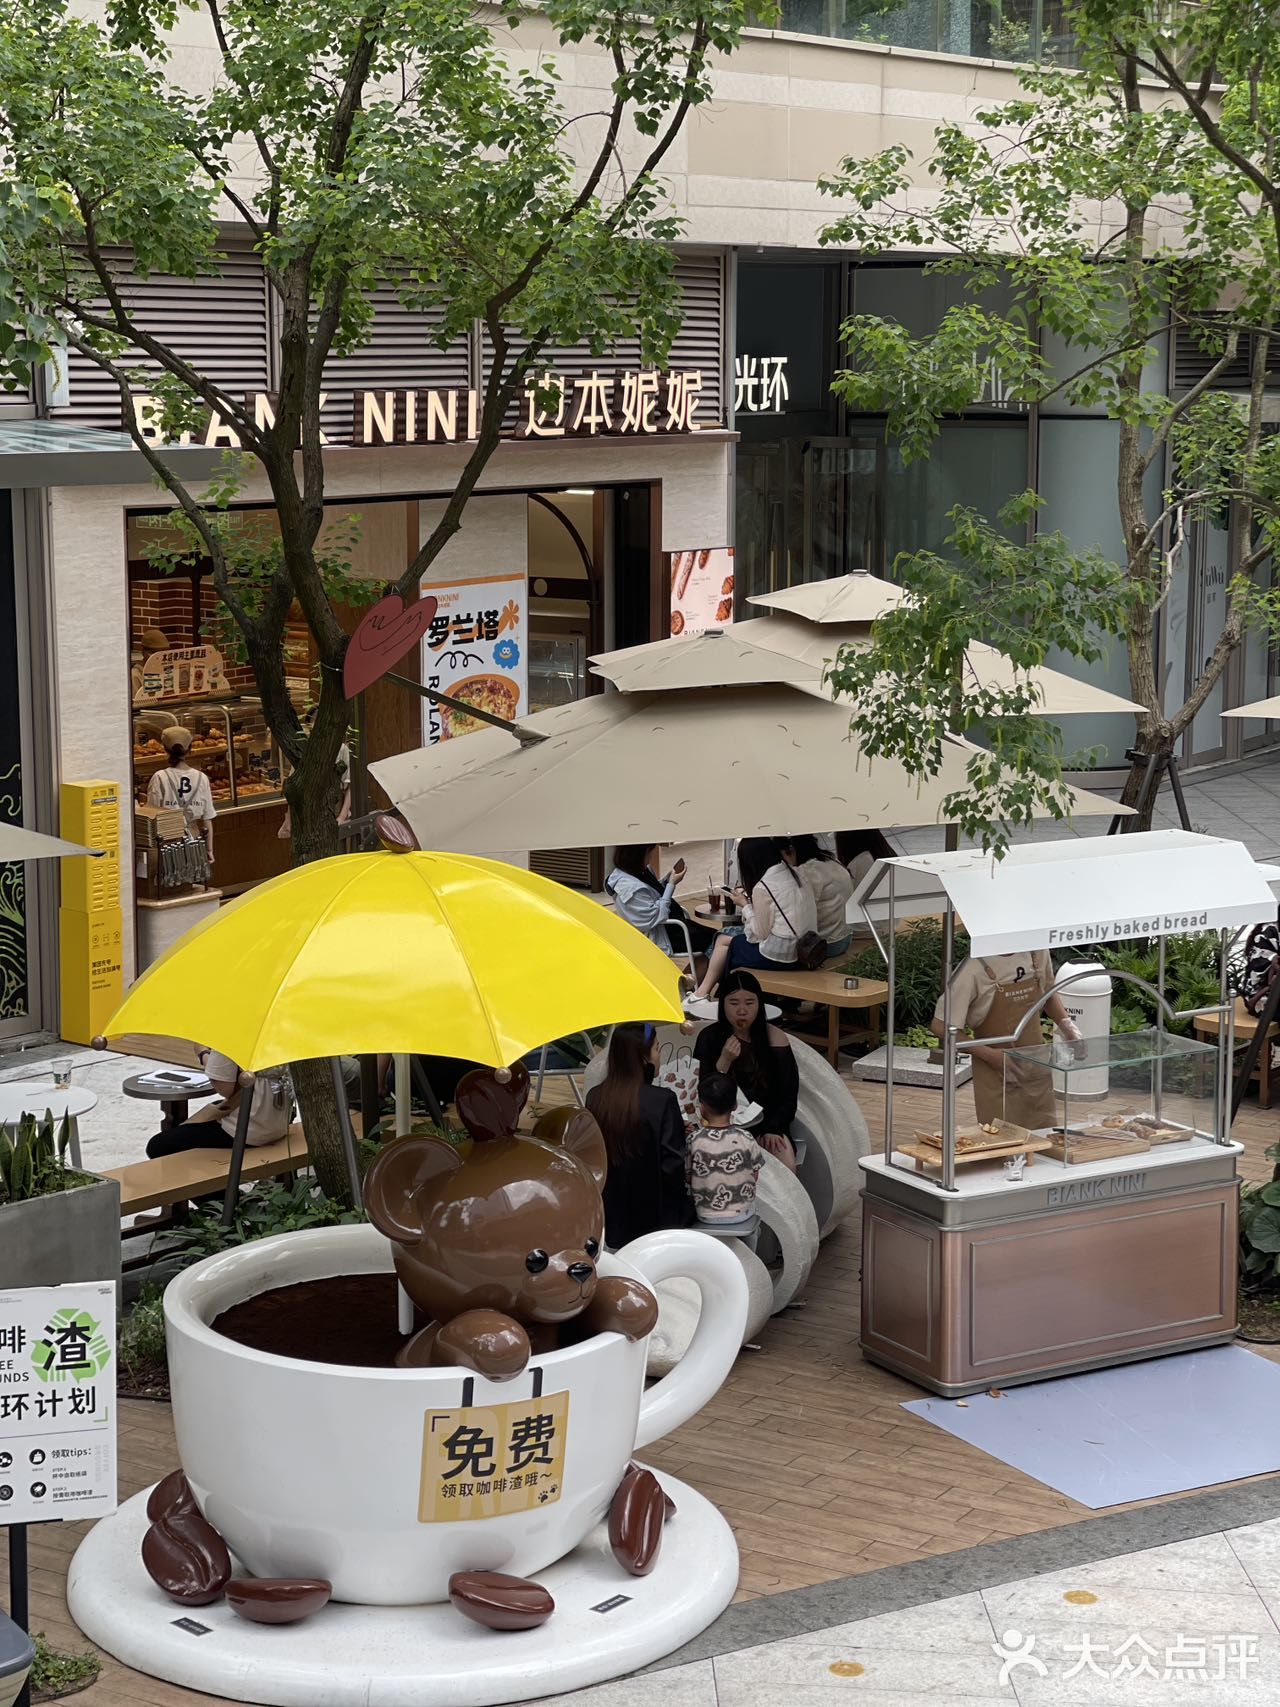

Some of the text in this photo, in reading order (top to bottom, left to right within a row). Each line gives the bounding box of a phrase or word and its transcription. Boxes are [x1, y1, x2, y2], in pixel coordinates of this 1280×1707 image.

[735, 354, 789, 412] 光环
[363, 389, 477, 443] NINI
[427, 609, 499, 648] 罗兰塔
[1049, 912, 1208, 943] Freshly baked bread
[1047, 1172, 1147, 1206] BIANK NINI
[1, 1386, 96, 1420] 环计划
[441, 1414, 555, 1480] 免费
